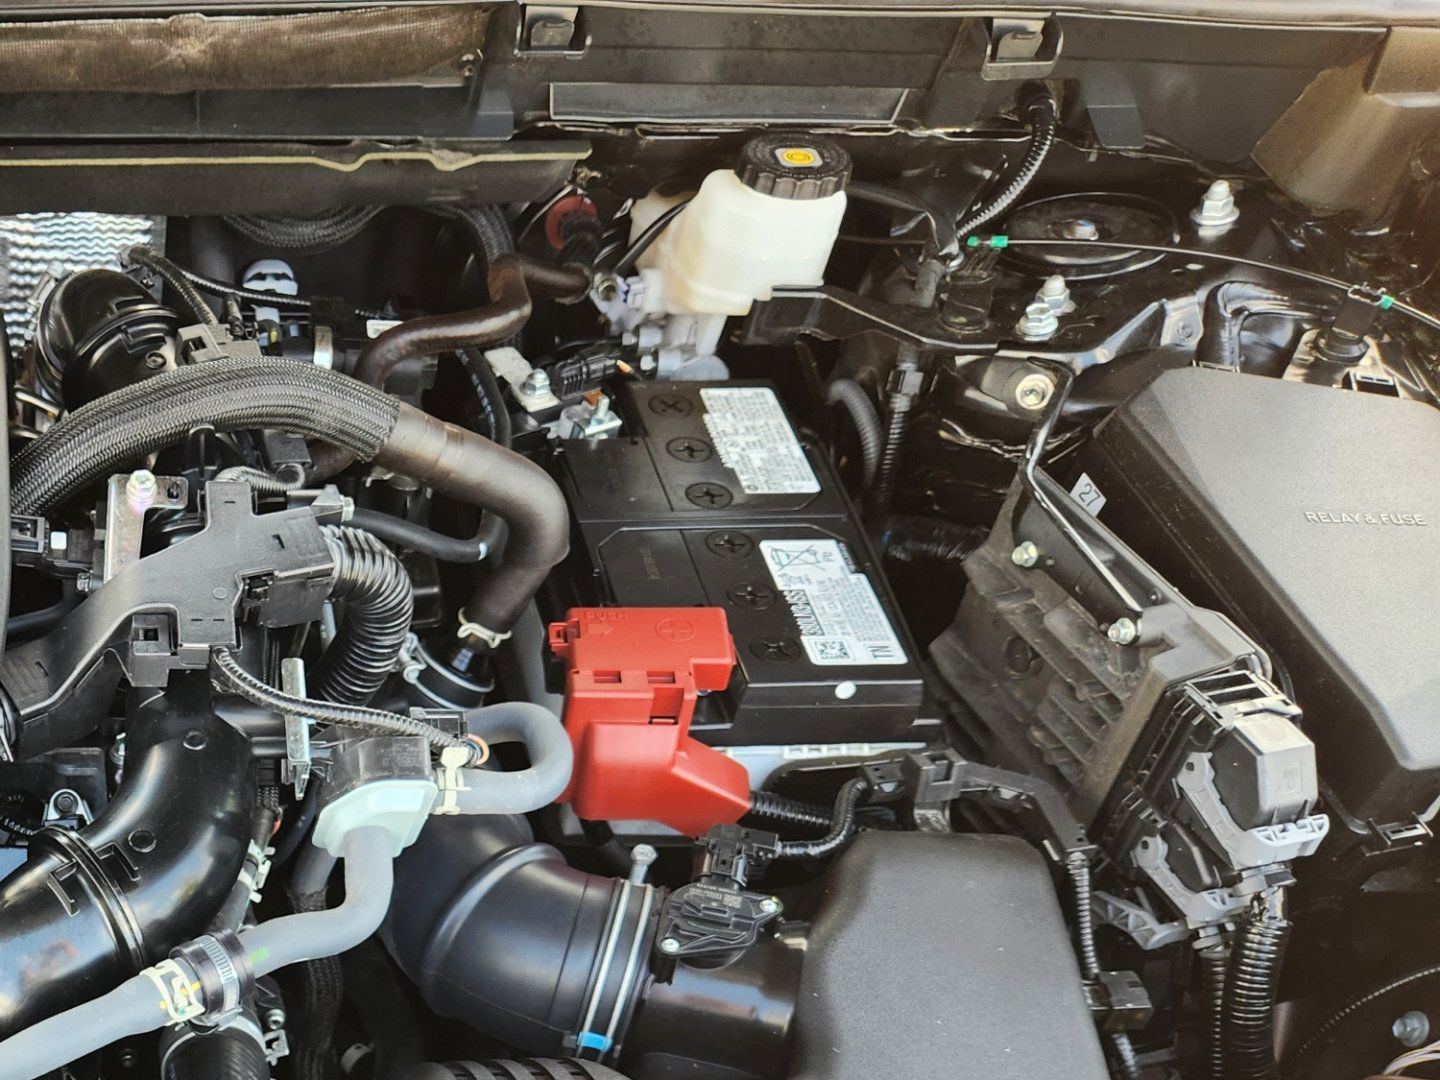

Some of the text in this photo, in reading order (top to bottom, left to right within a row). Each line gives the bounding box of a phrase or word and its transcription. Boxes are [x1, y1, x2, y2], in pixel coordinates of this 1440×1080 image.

[1078, 483, 1101, 507] 27
[1304, 511, 1427, 526] RELAY & FUSE
